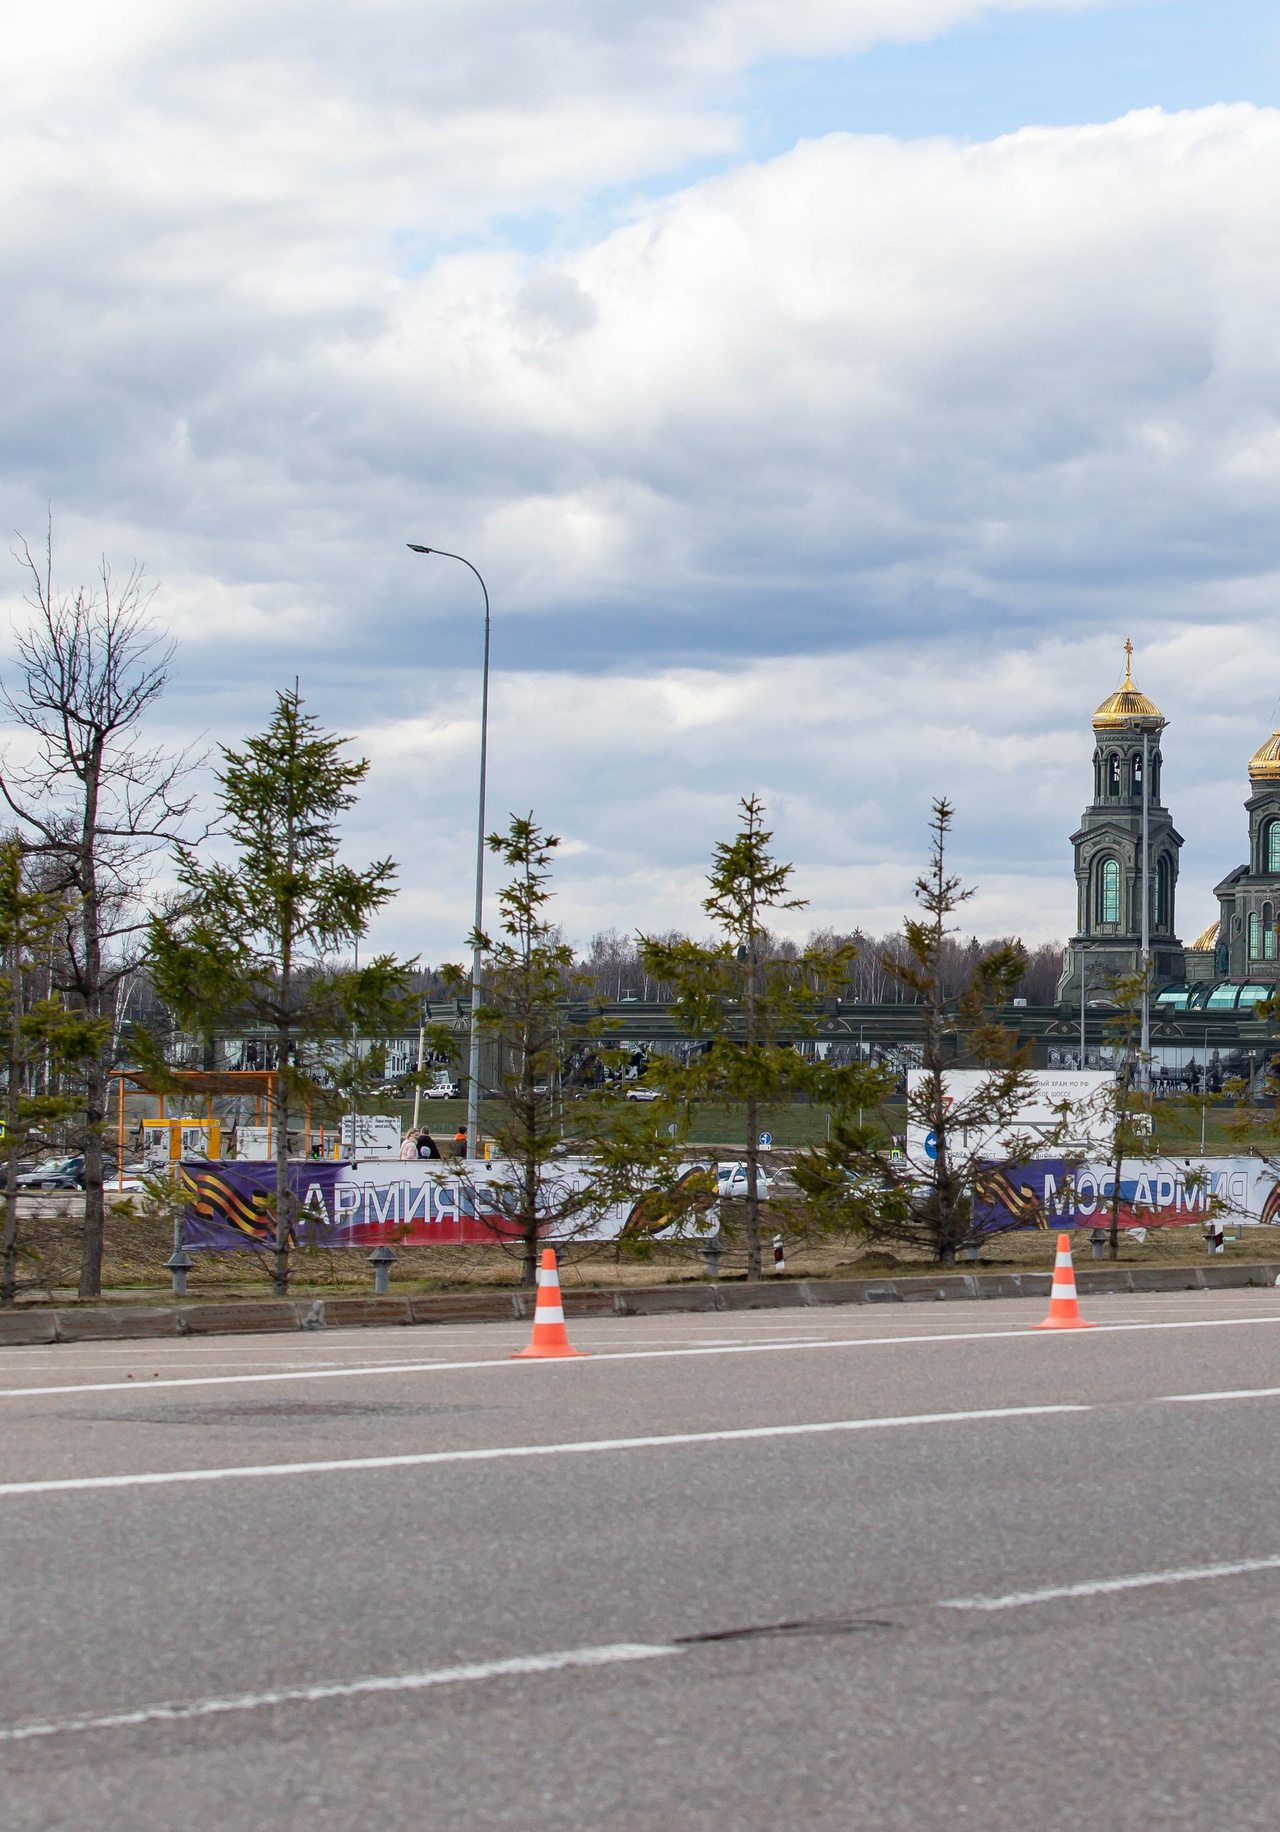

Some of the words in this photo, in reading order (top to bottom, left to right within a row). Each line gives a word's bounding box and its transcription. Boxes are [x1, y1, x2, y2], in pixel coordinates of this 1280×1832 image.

[298, 1180, 460, 1225] АРМИЯ
[1044, 1171, 1119, 1216] МОЯ
[1131, 1171, 1248, 1214] АРМИЯ
